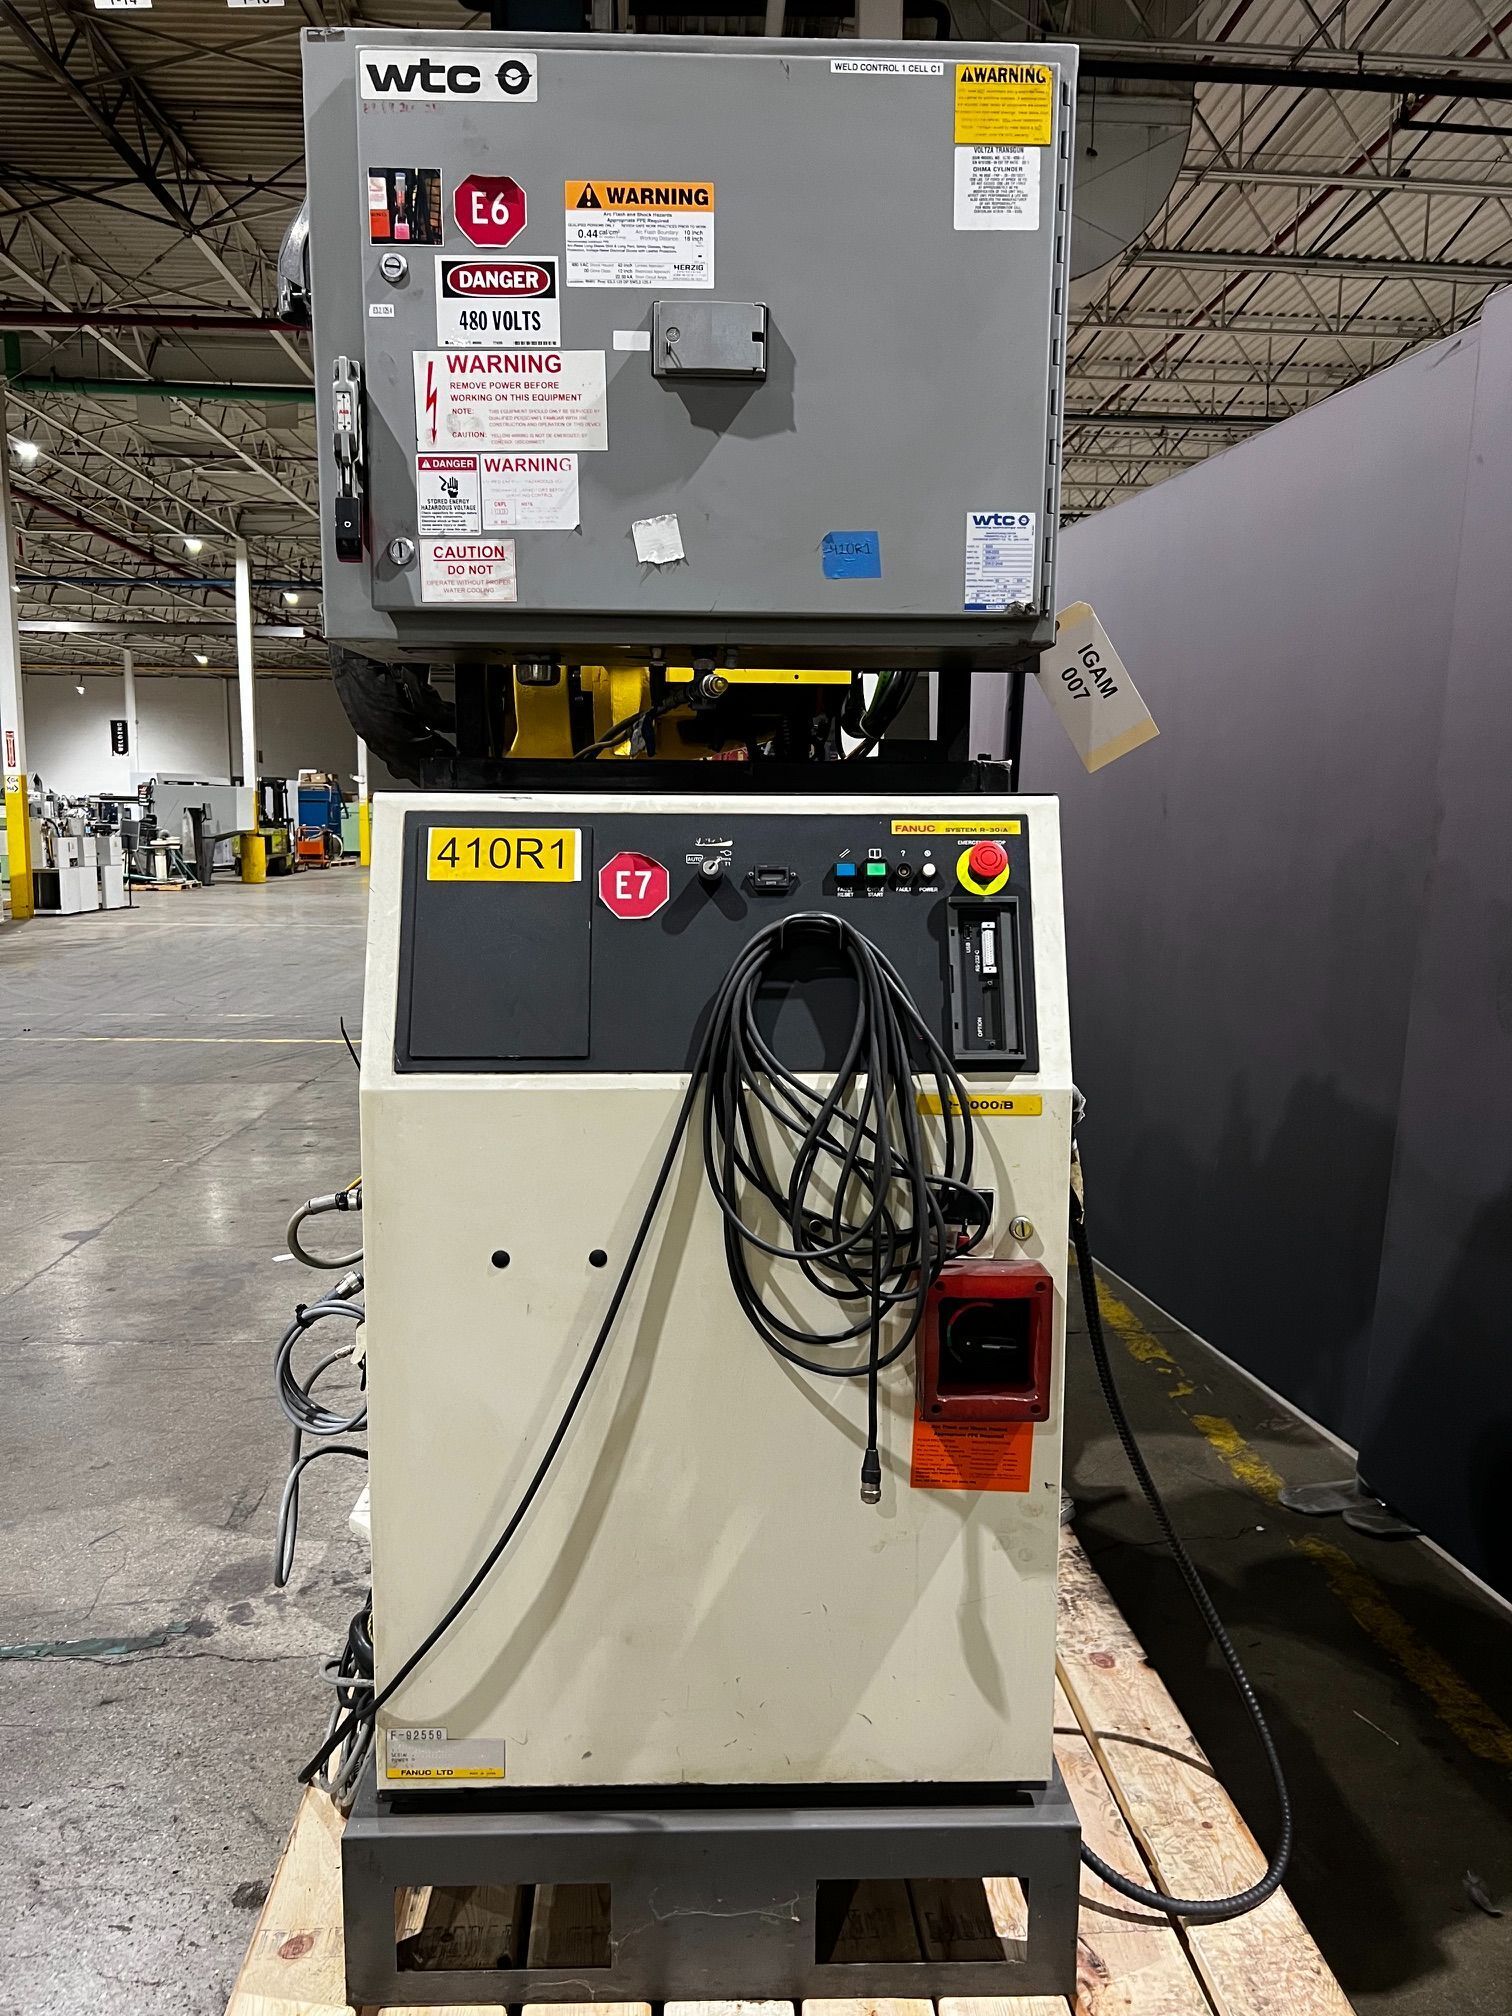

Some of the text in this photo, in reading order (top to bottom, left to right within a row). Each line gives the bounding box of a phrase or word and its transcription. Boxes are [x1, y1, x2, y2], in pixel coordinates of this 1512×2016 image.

[366, 58, 481, 94] wtc
[834, 63, 858, 71] WELD
[860, 64, 899, 72] CONTROL
[902, 64, 906, 72] 1
[931, 65, 940, 73] C1
[974, 66, 1046, 84] WARNING
[606, 187, 709, 206] WARNING
[472, 191, 510, 225] E6
[578, 229, 598, 238] 0.44
[459, 271, 539, 289] DANGER
[460, 310, 542, 331] 480 VOLTS
[446, 354, 562, 374] WARNING
[451, 394, 582, 402] WORKING ON THIS EQUIPMENT
[433, 460, 474, 468] DANGER
[484, 458, 572, 472] WARNING
[972, 514, 1015, 526] wtc
[433, 546, 504, 558] CAUTION
[448, 566, 494, 574] DO NOT
[1078, 643, 1118, 699] IGAM
[1061, 667, 1091, 699] 007
[437, 837, 564, 870] 410R1
[616, 870, 652, 900] E7
